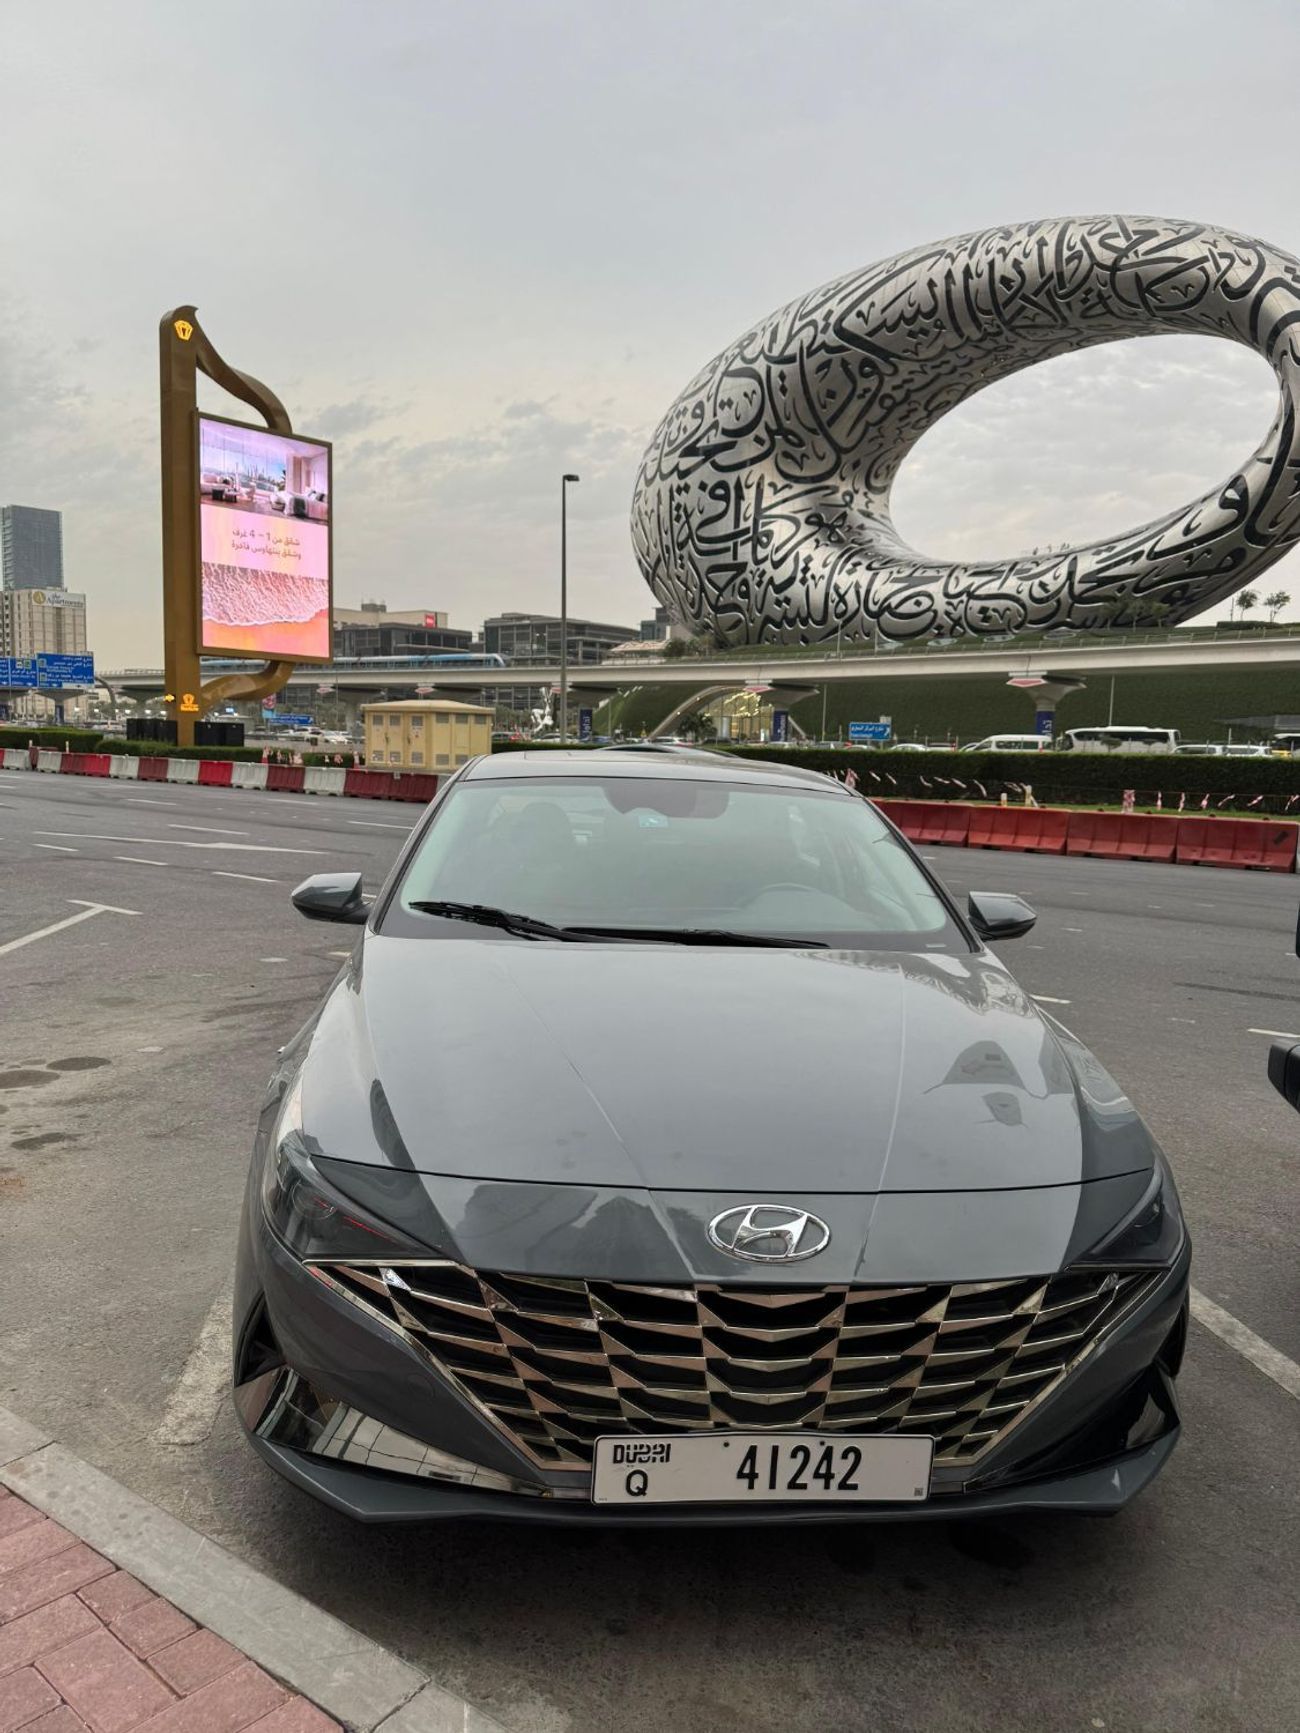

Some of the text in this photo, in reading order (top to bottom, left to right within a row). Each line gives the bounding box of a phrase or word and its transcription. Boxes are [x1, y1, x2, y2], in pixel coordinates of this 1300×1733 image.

[612, 1443, 672, 1465] DUBAI
[736, 1444, 862, 1490] 41242
[625, 1469, 648, 1497] Q
